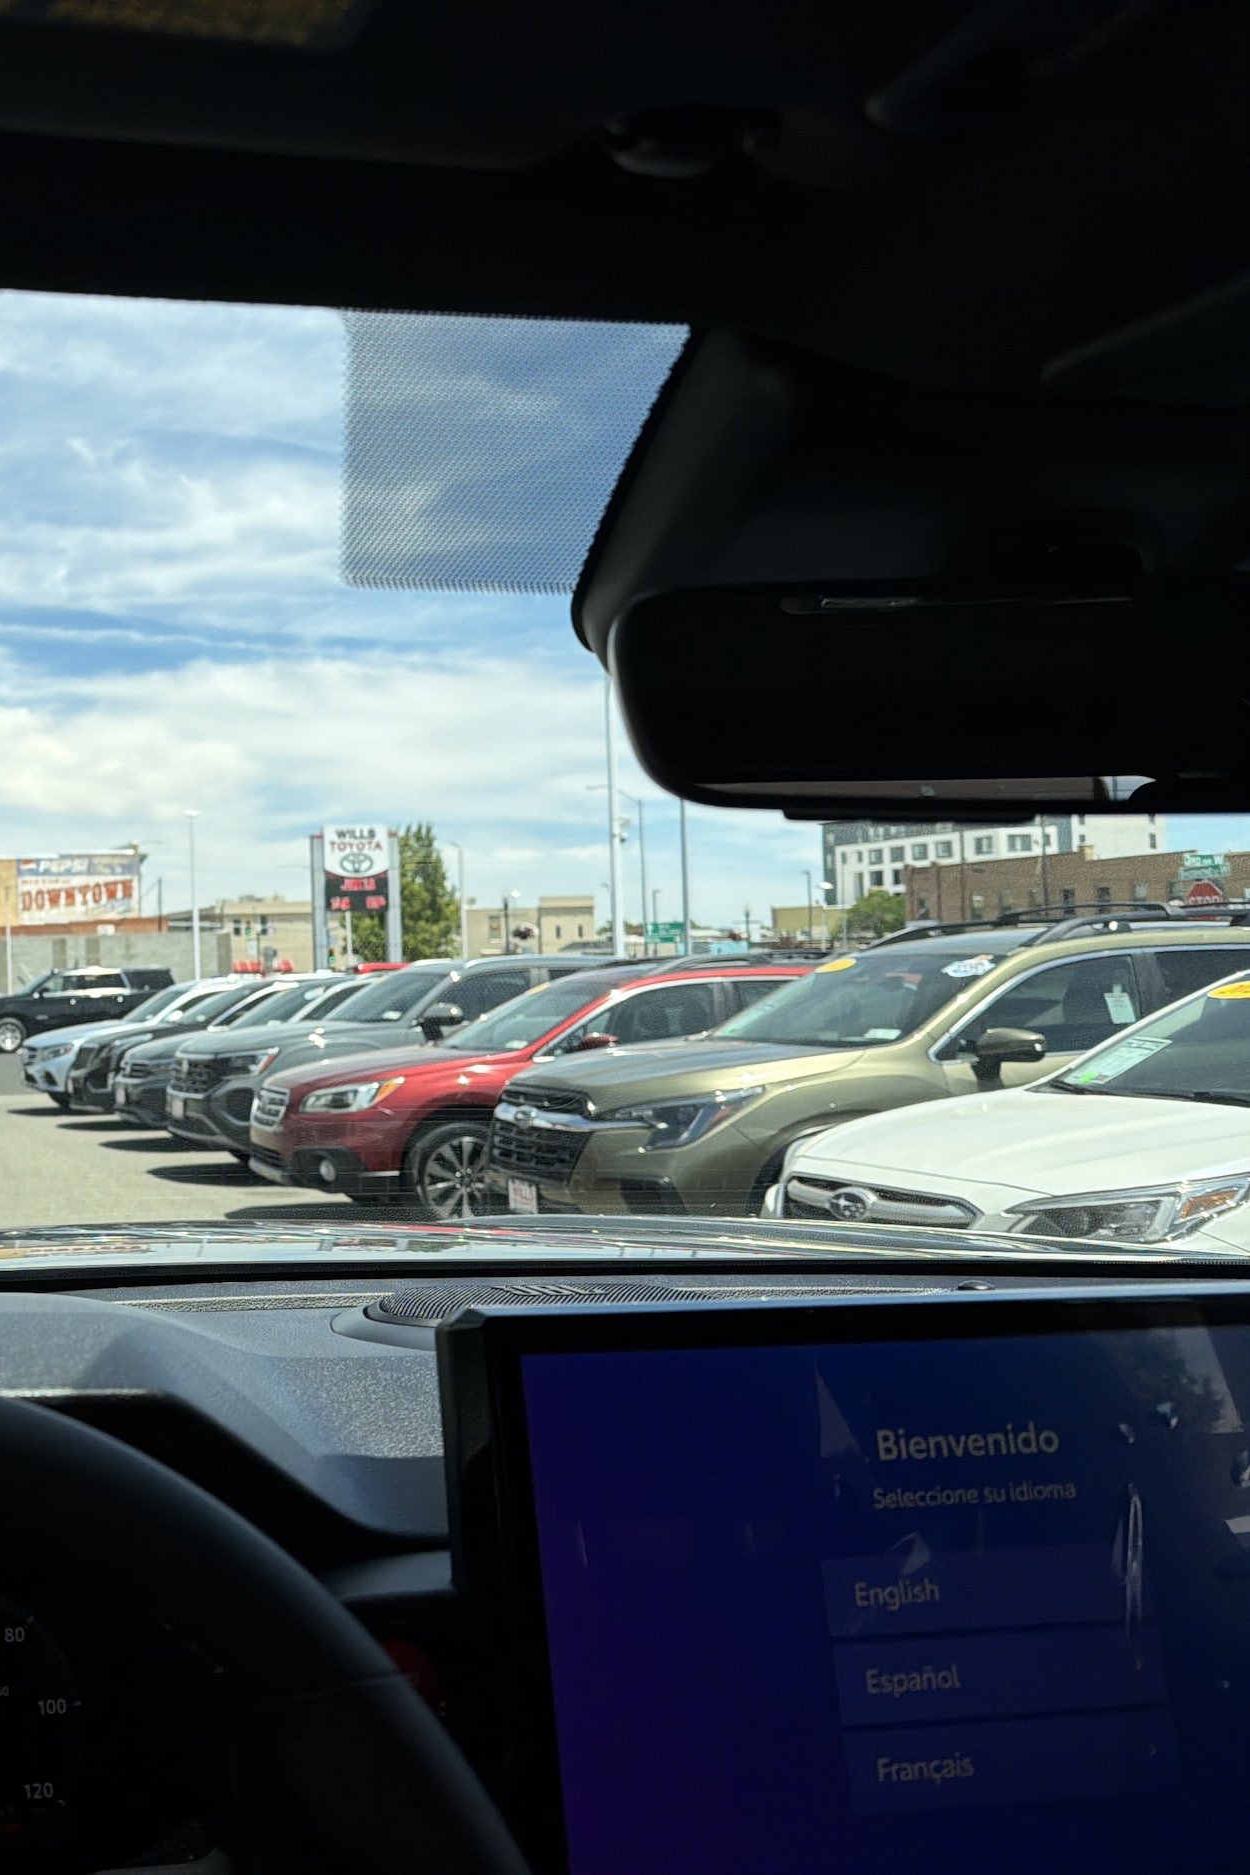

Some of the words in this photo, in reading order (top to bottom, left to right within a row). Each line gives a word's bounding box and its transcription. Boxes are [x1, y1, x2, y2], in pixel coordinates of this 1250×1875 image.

[329, 841, 382, 852] TOYOTA
[335, 828, 375, 839] WILLS
[21, 879, 133, 911] DOWNTOWN
[876, 1421, 1060, 1462] Bienvenido
[872, 1484, 979, 1510] Seleccione
[983, 1486, 1005, 1503] su
[1009, 1480, 1077, 1502] idioma
[855, 1578, 940, 1612] English
[3, 1626, 26, 1642] 80
[865, 1663, 962, 1697] Español
[38, 1699, 67, 1714] 100
[877, 1752, 975, 1784] Français
[24, 1782, 54, 1799] 120
